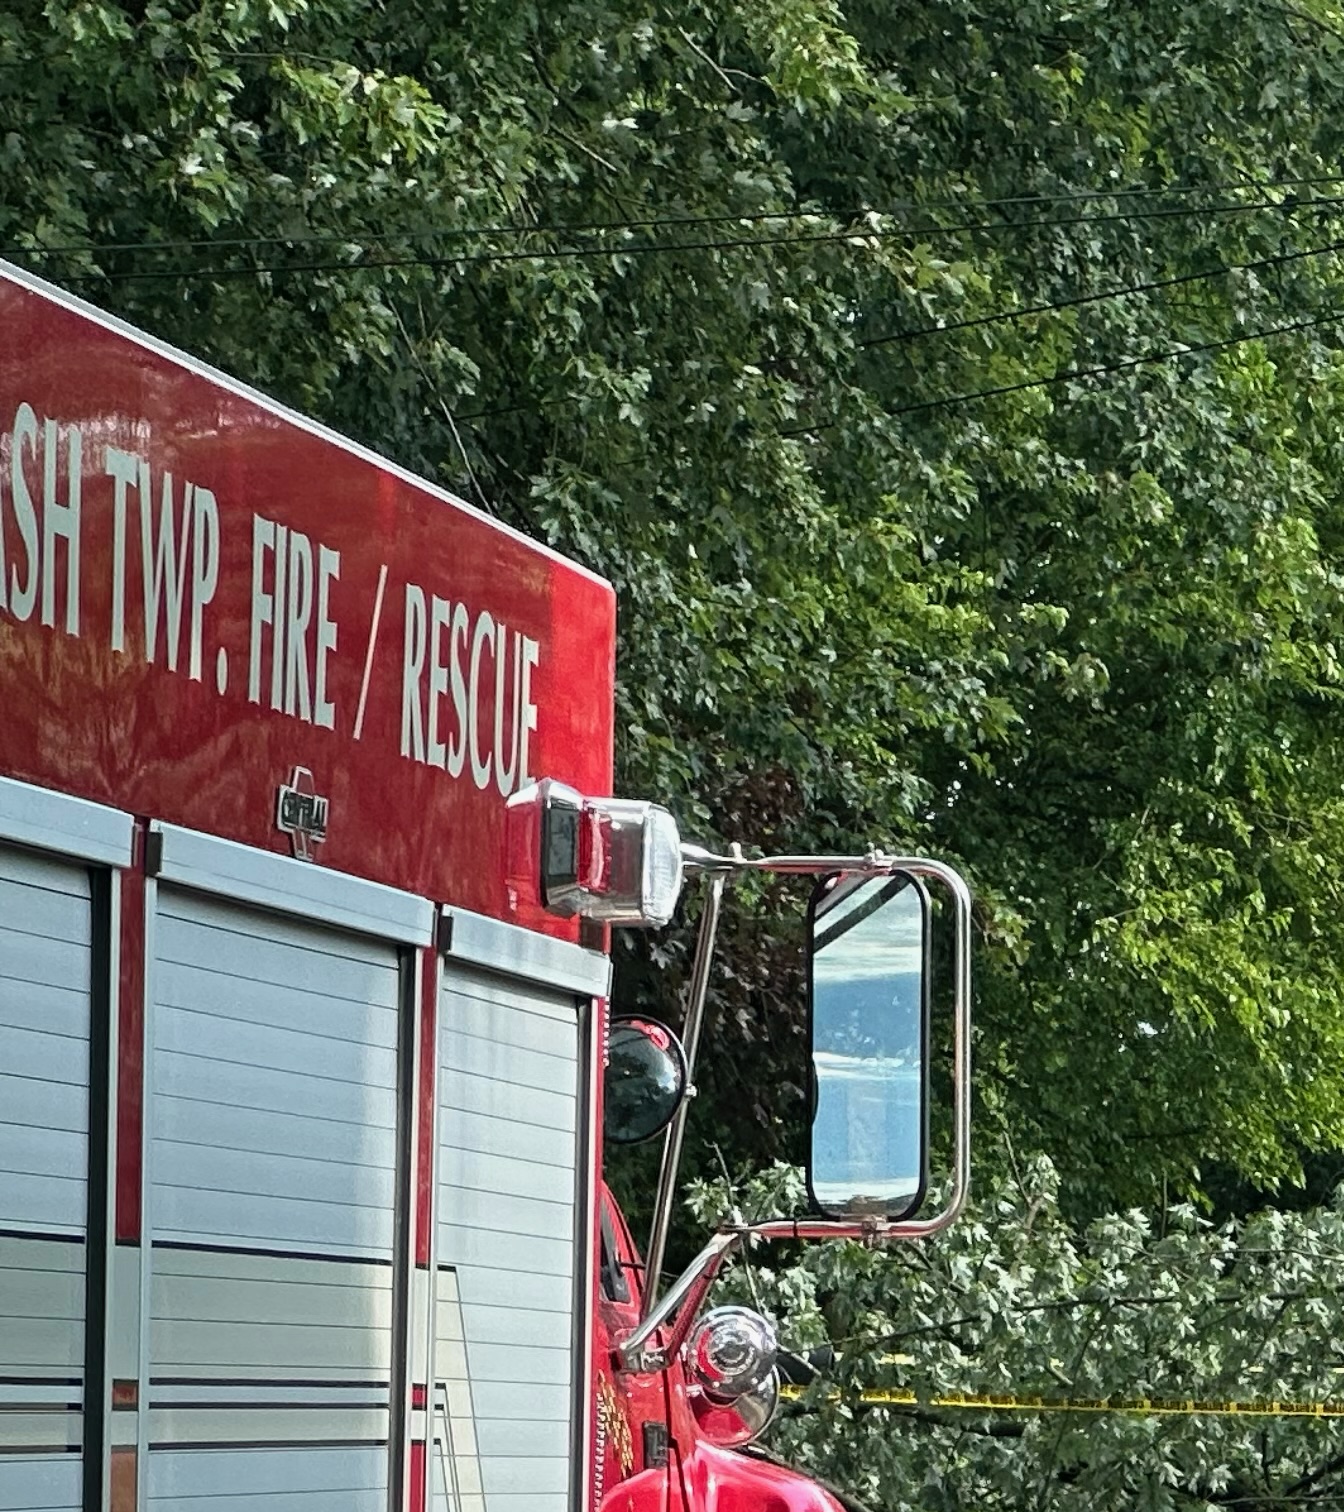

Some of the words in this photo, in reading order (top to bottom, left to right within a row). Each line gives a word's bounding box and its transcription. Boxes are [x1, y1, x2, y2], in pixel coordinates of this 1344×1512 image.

[0, 402, 83, 638] SH
[105, 445, 228, 697] TWP.
[248, 512, 341, 731] FIRE
[353, 564, 389, 742] /
[400, 582, 540, 798] RESCUE
